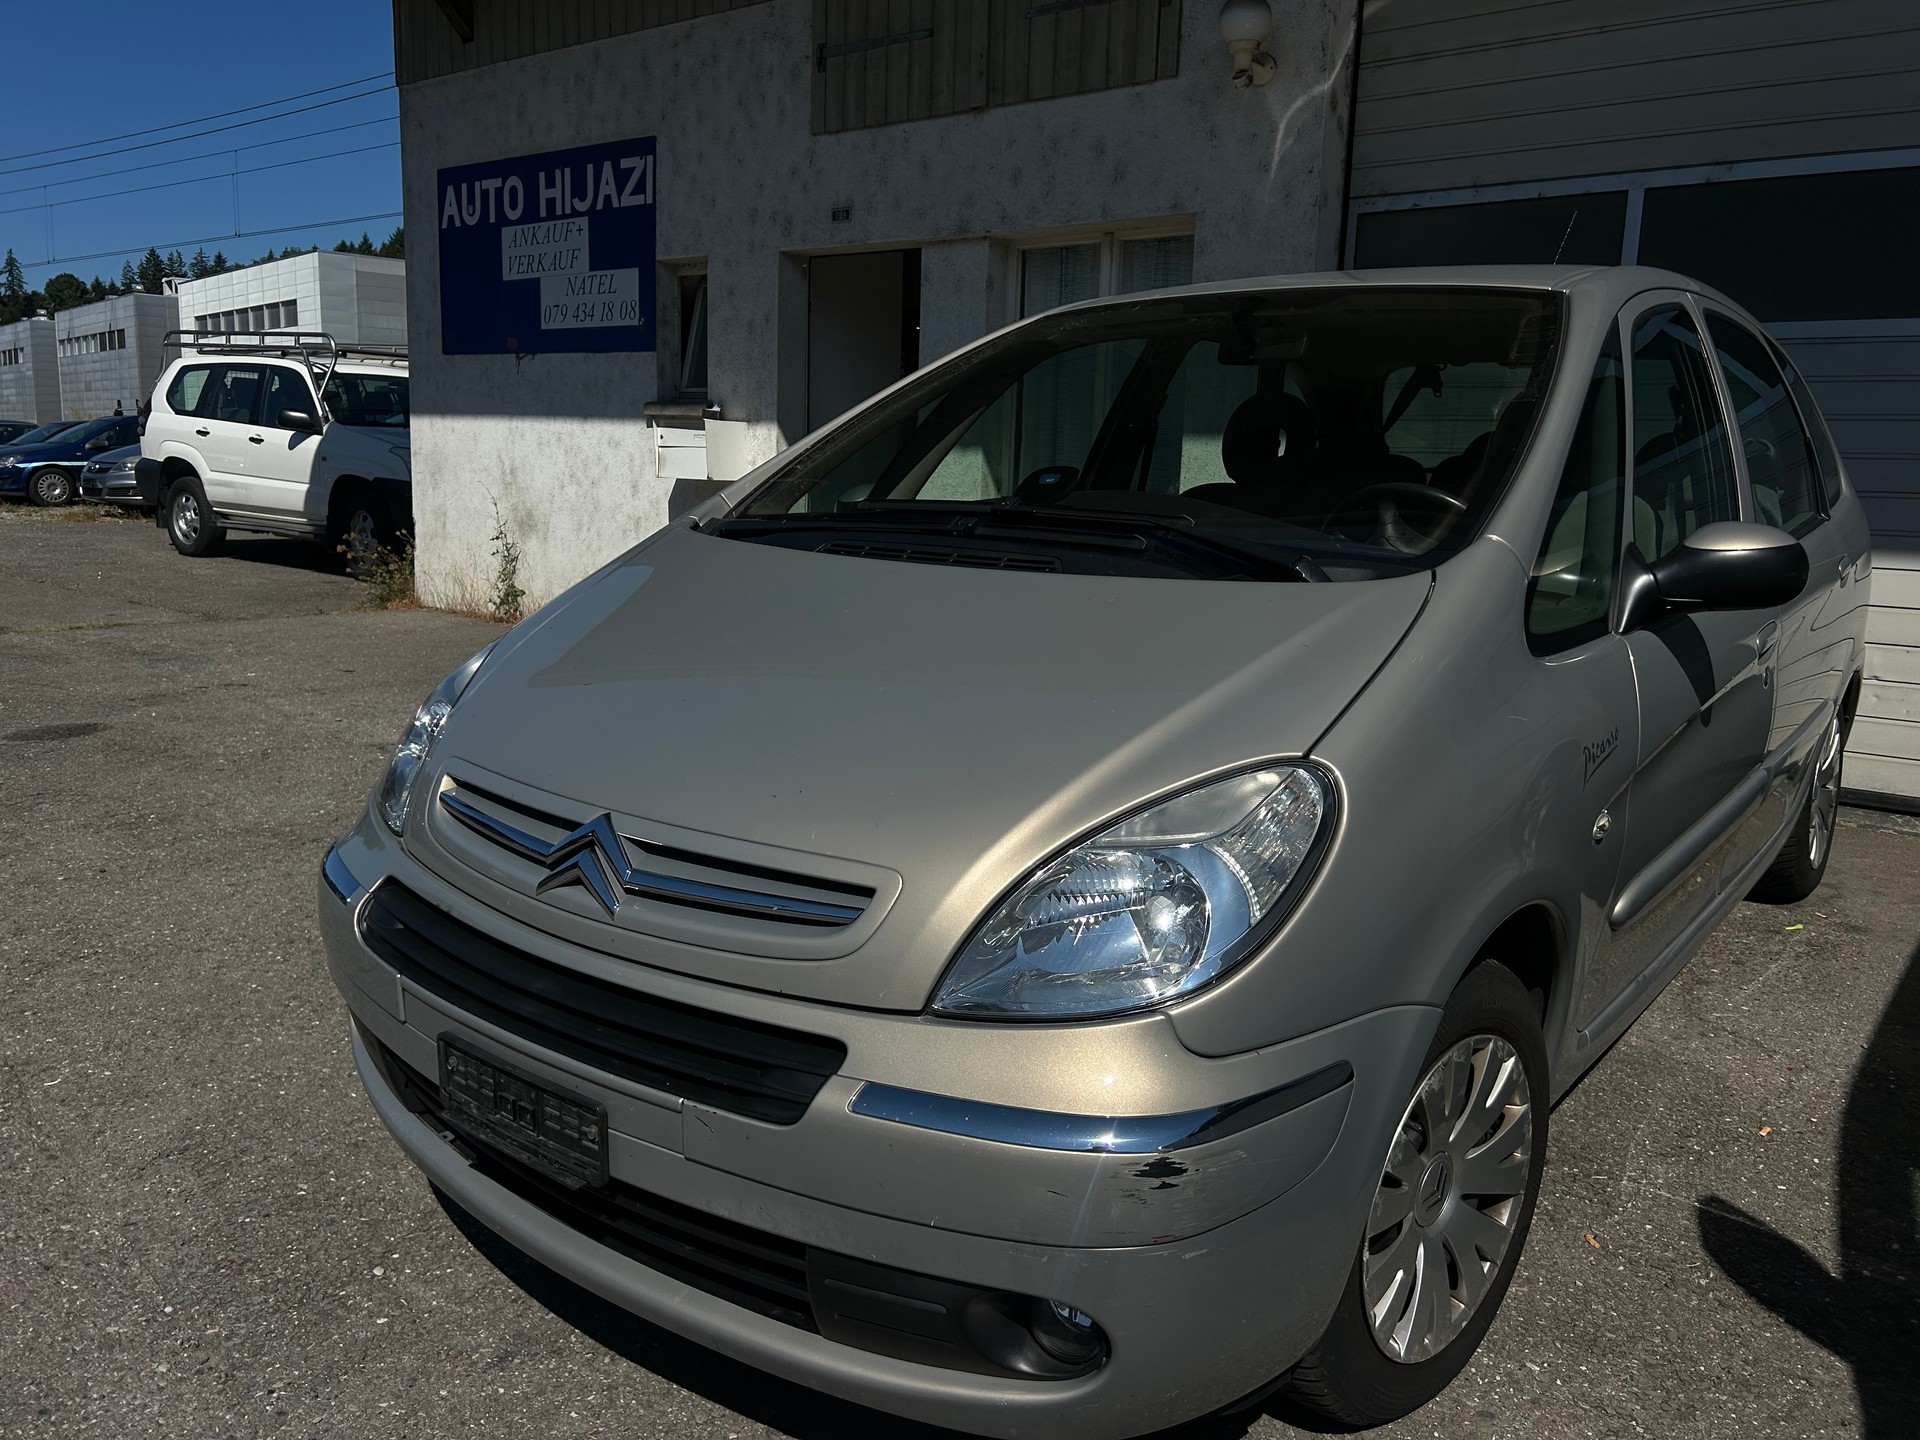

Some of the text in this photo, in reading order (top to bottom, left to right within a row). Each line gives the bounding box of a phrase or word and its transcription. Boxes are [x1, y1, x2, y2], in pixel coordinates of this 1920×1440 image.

[441, 154, 654, 229] AUTO HIJAZI
[508, 221, 584, 249] ANKAUF+
[507, 248, 581, 275] VERKAUF
[565, 273, 617, 297] NATEL
[543, 299, 637, 325] 079 434 18 08
